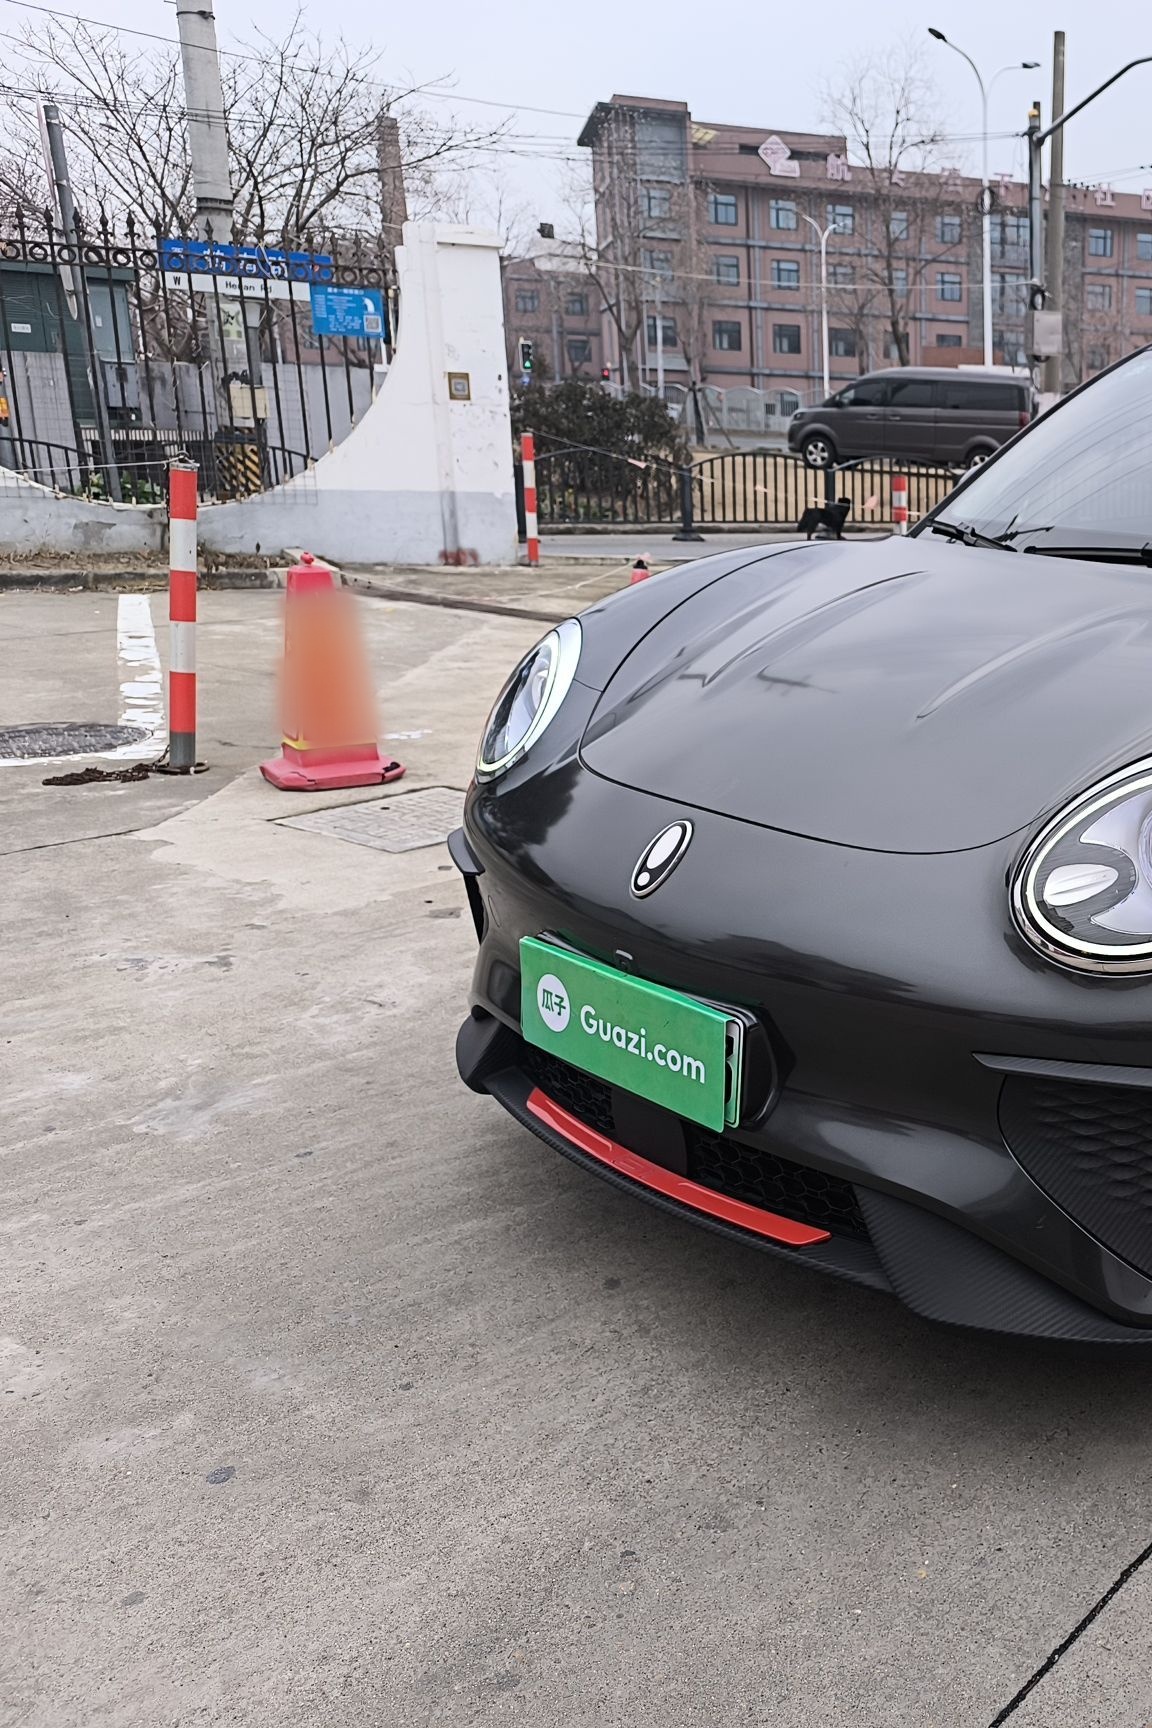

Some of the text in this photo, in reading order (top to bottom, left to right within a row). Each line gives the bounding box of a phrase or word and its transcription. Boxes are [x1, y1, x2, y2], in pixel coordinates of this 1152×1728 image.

[173, 276, 181, 286] W
[541, 988, 567, 1017] 瓜子
[580, 1004, 706, 1085] Guazi.com
